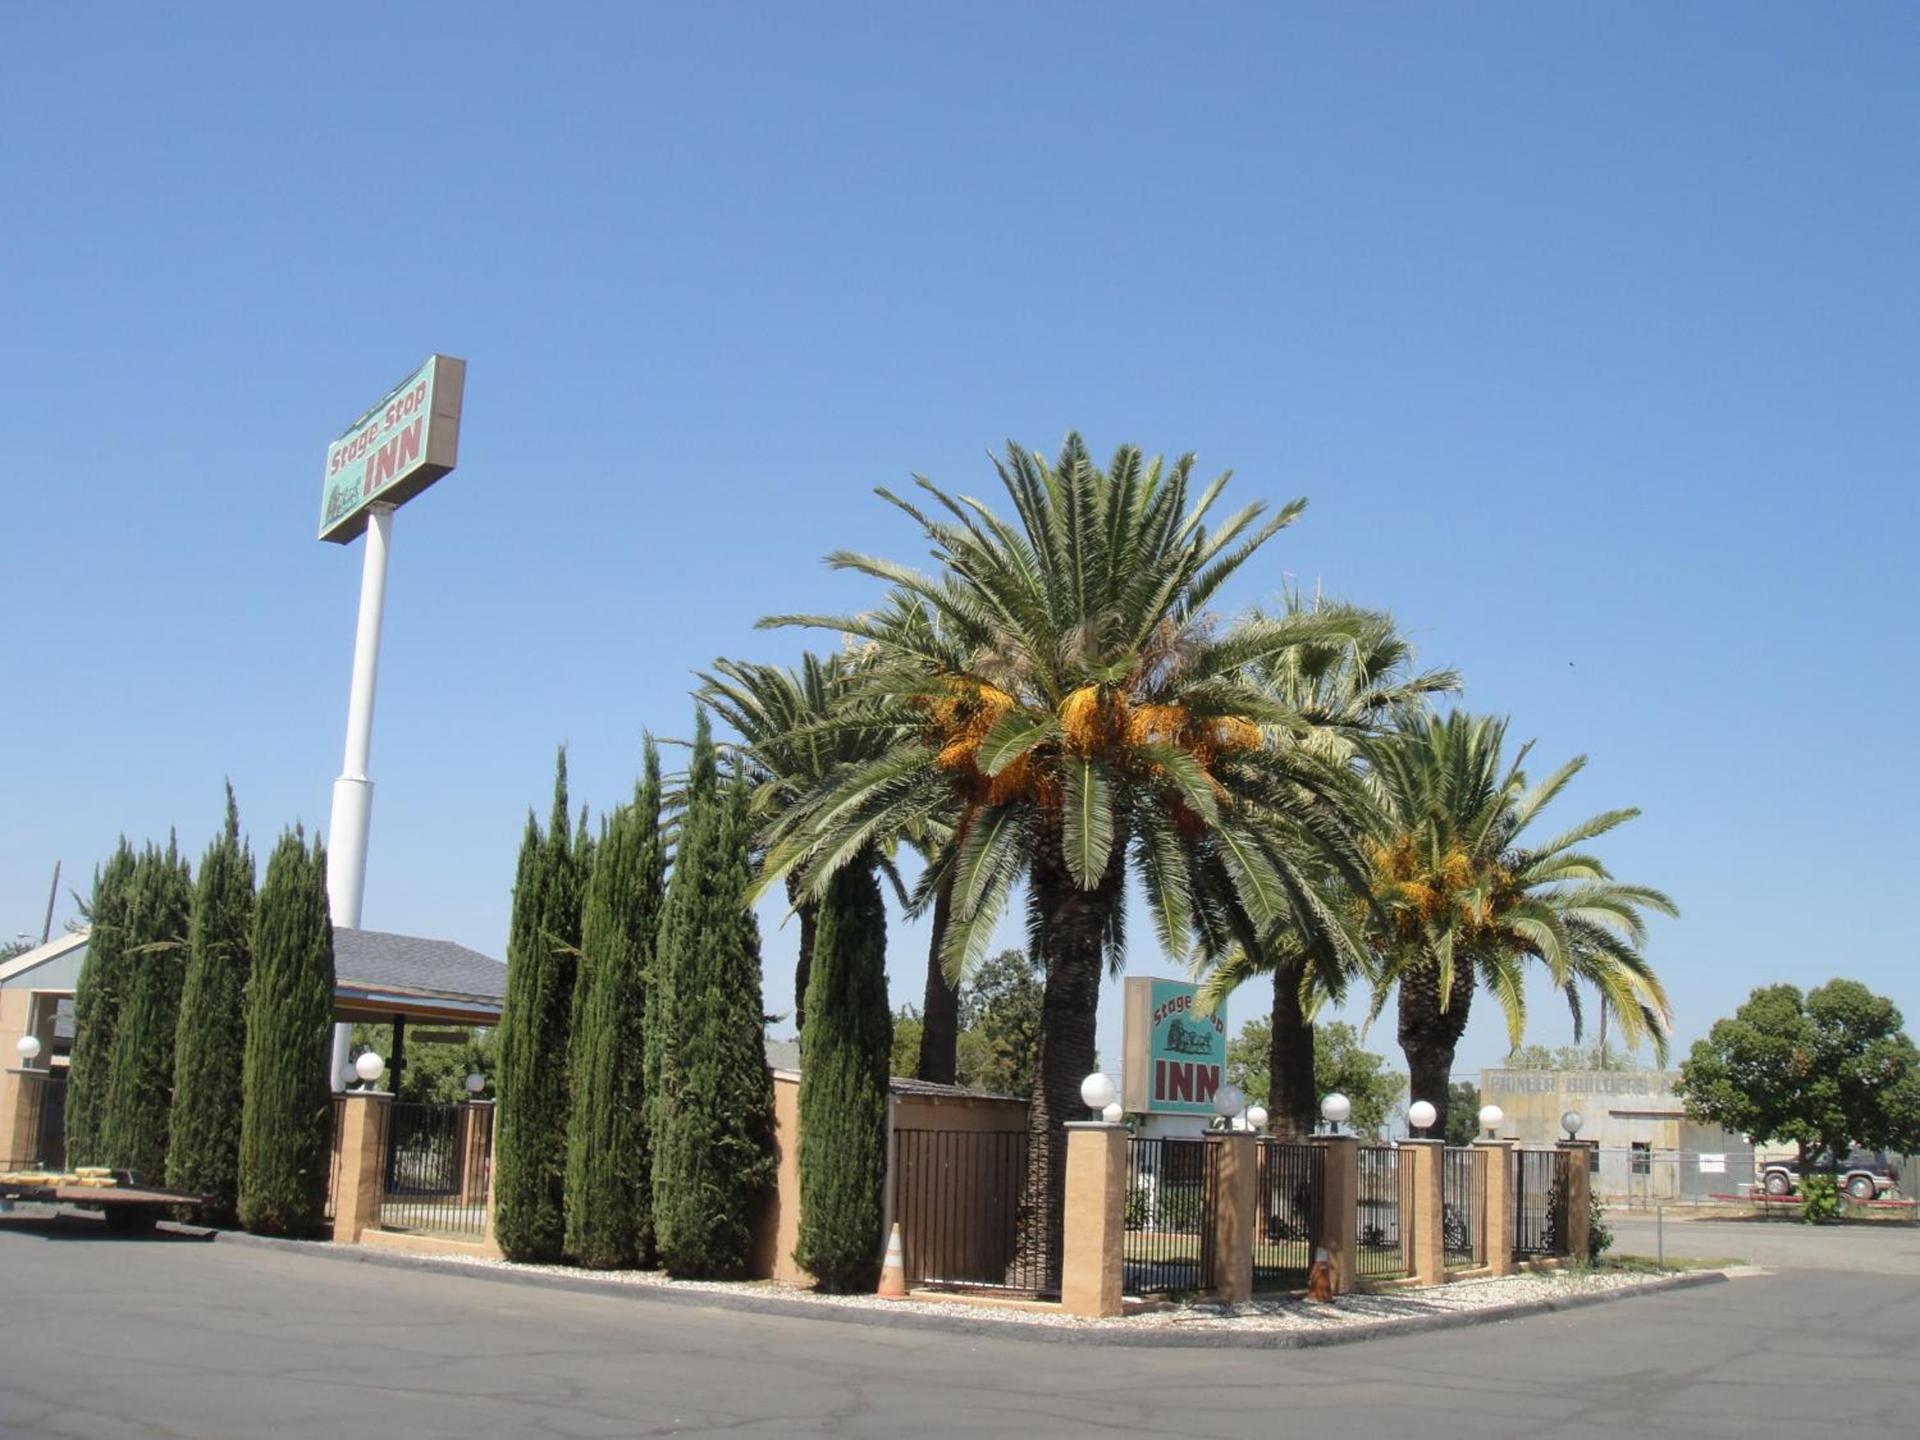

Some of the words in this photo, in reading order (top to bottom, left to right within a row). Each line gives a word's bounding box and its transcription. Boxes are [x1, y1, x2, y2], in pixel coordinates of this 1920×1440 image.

[331, 422, 378, 476] Stage
[384, 380, 427, 431] Stop
[363, 416, 423, 497] INN
[1153, 995, 1192, 1027] Stage
[1154, 1059, 1220, 1103] INN
[1565, 1076, 1648, 1096] BUILDERS
